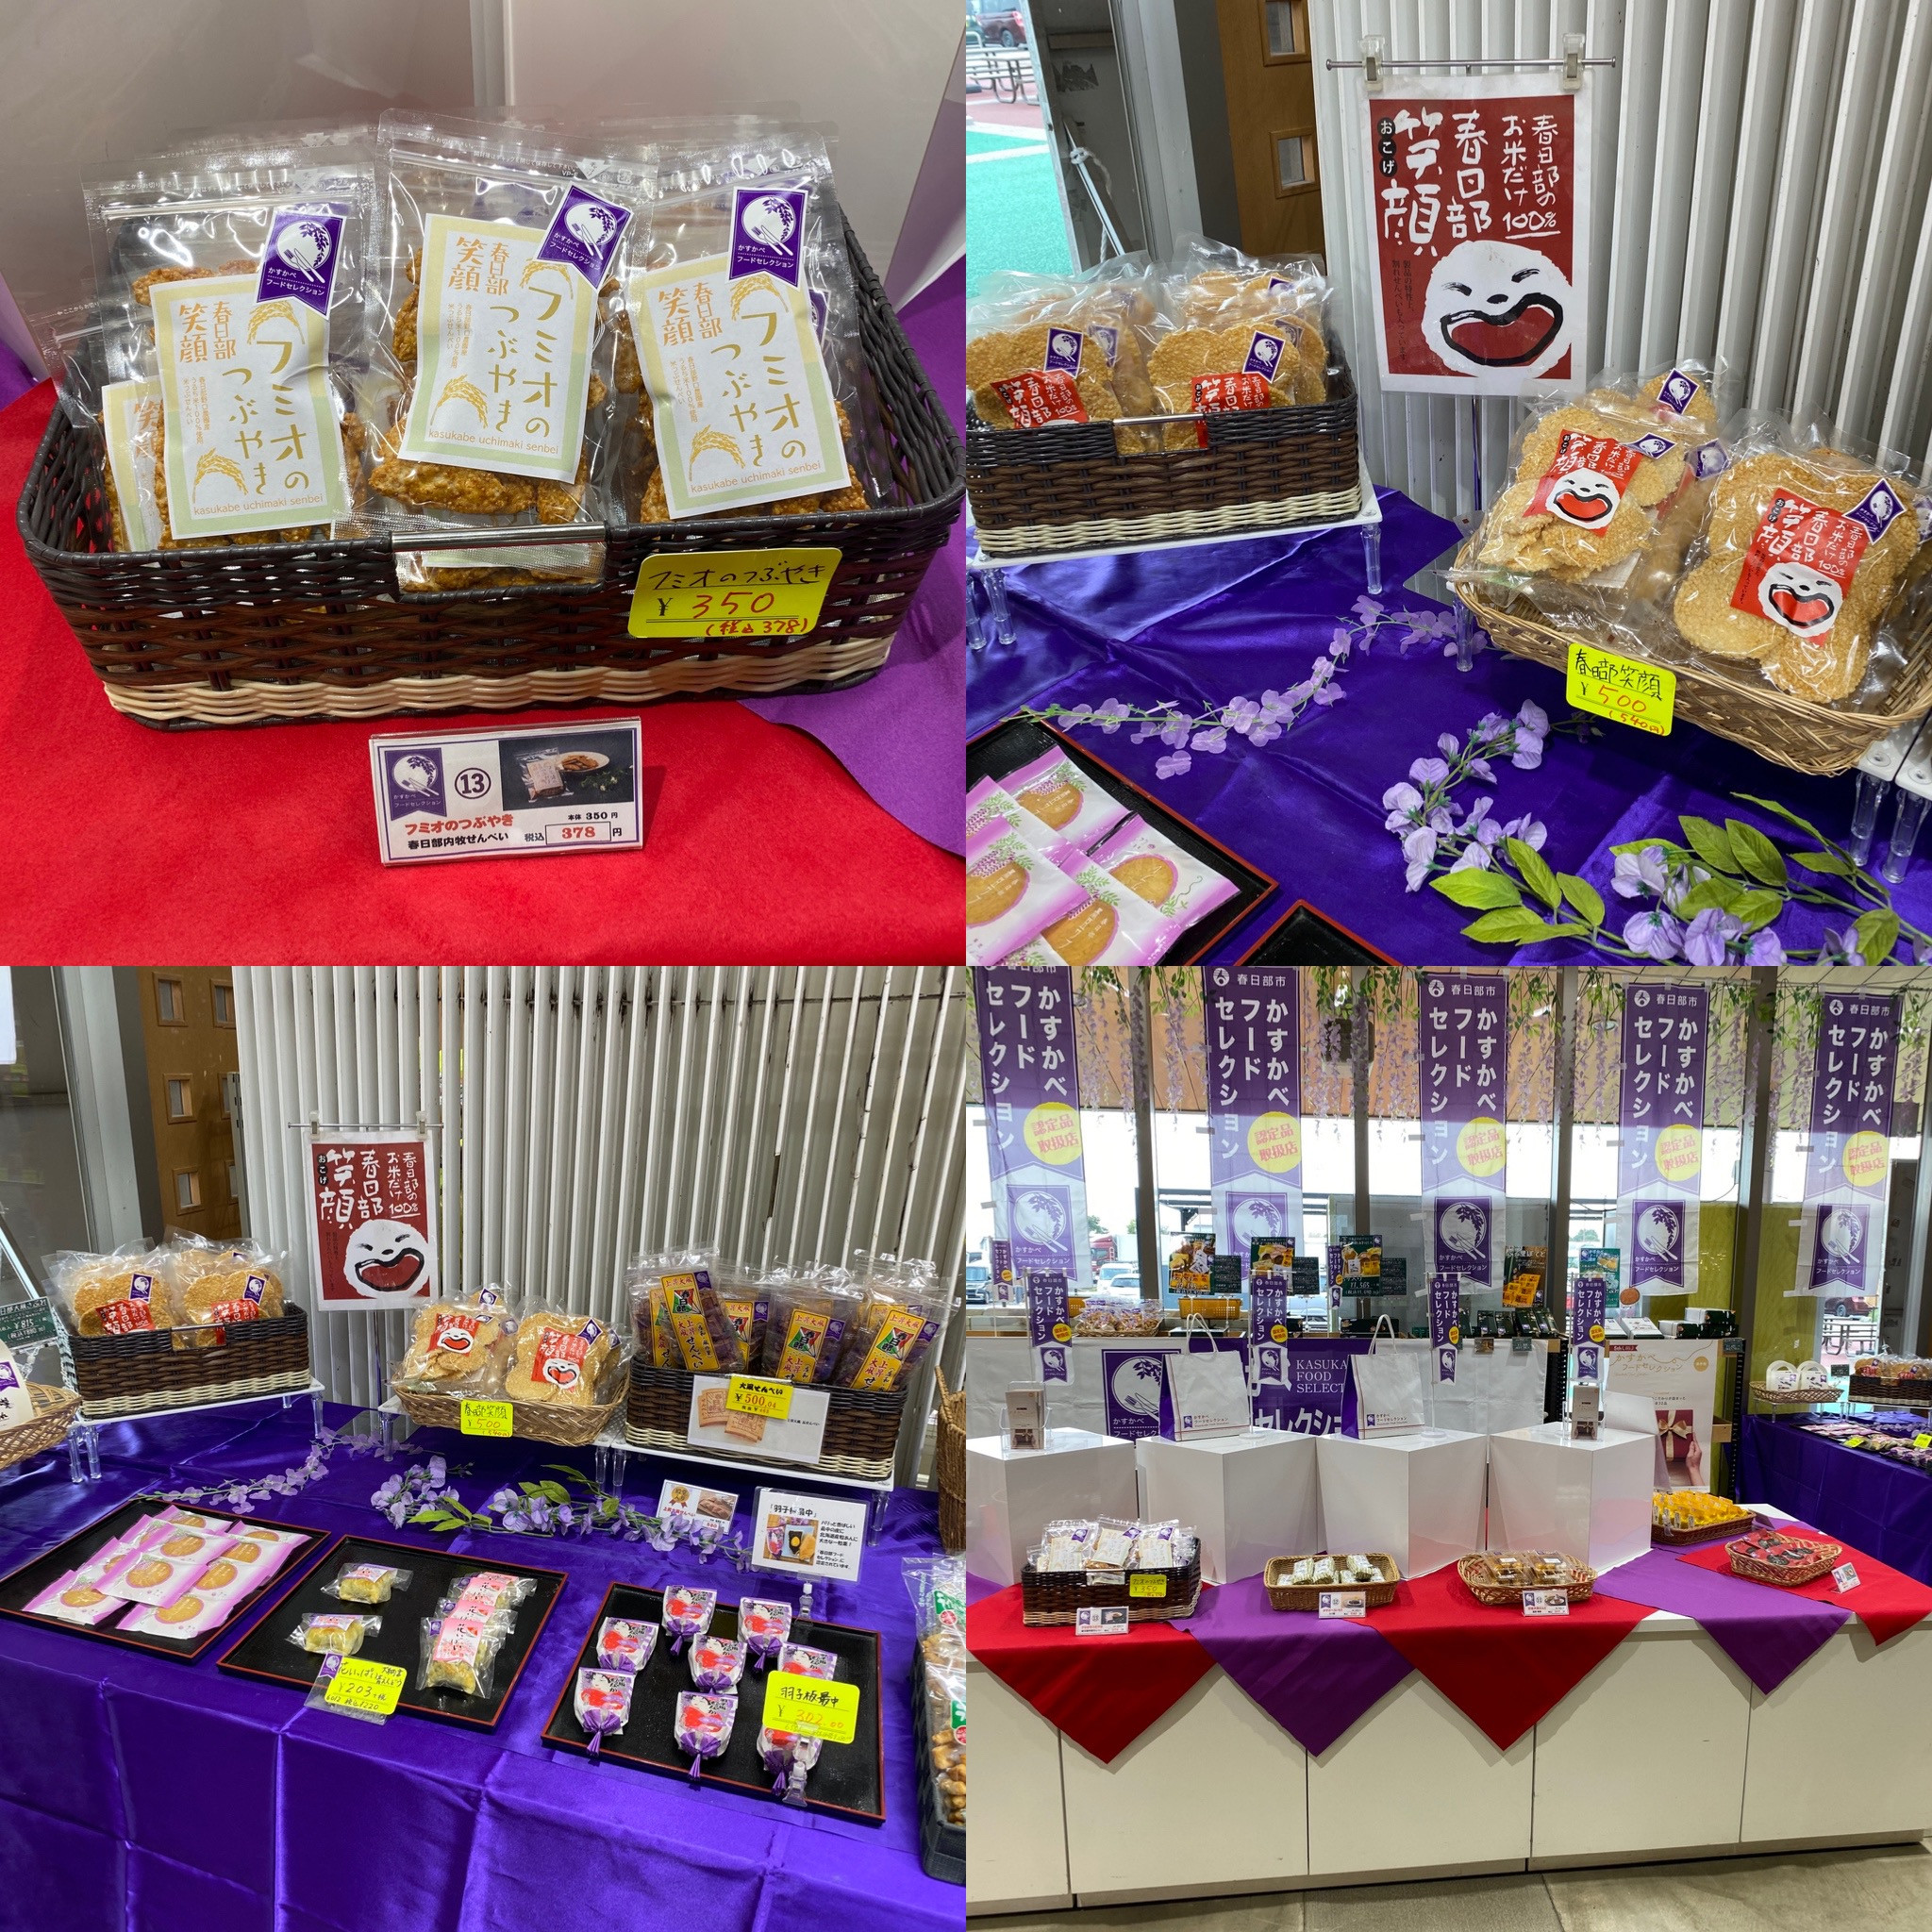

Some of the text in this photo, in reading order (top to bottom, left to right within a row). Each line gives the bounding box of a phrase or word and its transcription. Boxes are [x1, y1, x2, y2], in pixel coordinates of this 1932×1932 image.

[1380, 121, 1395, 175] おこげ
[1501, 114, 1529, 207] お米だけ
[1531, 114, 1560, 208] 春日部の
[1381, 107, 1445, 258] 笑顔
[1446, 109, 1493, 239] 春日部
[1502, 210, 1557, 232] 100%
[448, 236, 488, 293] 笑顔
[485, 242, 510, 297] 春日部
[549, 241, 602, 271] フードセレクション
[737, 256, 794, 269] フードセレクション
[266, 278, 325, 296] フードセレクション
[212, 301, 236, 360] 春日部
[658, 287, 695, 347] 笑顔
[693, 282, 724, 340] 春日部
[178, 303, 209, 364] 笑顔
[488, 305, 520, 433] つぶやき
[523, 286, 561, 439] フミオの
[710, 342, 764, 467] つぶやき
[741, 312, 808, 460] フミオの
[1024, 377, 1052, 424] 春日部
[222, 368, 268, 495] つぶやき
[256, 340, 310, 491] フミオの
[428, 428, 559, 455] kasukabe uchimaki senbei
[691, 460, 823, 494] kasukabe uchimaki senbei
[193, 492, 324, 517] kasukabe uchimaki senbei
[1767, 499, 1785, 524] おこげ
[1756, 499, 1811, 561] 笑顔
[1790, 510, 1829, 563] 春日部
[1824, 519, 1849, 560] お米だけ
[1839, 525, 1863, 567] 春日部の
[649, 560, 826, 590] フミオのつぶやき
[405, 814, 514, 836] フミオのつぶやき
[525, 825, 623, 842] 税込 378 円
[586, 812, 608, 821] 350
[408, 833, 509, 850] 春日部内牧せんべい
[1237, 974, 1287, 987] 春日部市
[1451, 984, 1496, 996] 春日部市
[1656, 993, 1698, 1007] 春日部市
[1010, 984, 1035, 1069] フード
[1849, 1004, 1890, 1017] 春日部市
[1039, 986, 1068, 1096] かすかべ
[1241, 999, 1261, 1081] フード
[1266, 999, 1290, 1107] かすかべ
[1454, 1008, 1473, 1088] フード
[1476, 1008, 1498, 1111] かすかべ
[1657, 1017, 1674, 1094] フード
[986, 981, 1014, 1150] セレクション
[1215, 996, 1240, 1159] セレクション
[1429, 1007, 1449, 1165] セレクション
[1674, 1017, 1698, 1120] かすかべ
[1847, 1027, 1866, 1103] フード
[1862, 1027, 1888, 1125] かすかべ
[1631, 1016, 1653, 1169] セレクション
[1818, 1024, 1845, 1174] セレクション
[1031, 1114, 1074, 1136] 認定品
[1037, 1131, 1079, 1154] 取扱店
[1255, 1123, 1294, 1145] 認定品
[1463, 1128, 1500, 1150] 認定品
[1660, 1134, 1696, 1155] 認定品
[318, 1155, 327, 1185] おこげ
[1259, 1141, 1298, 1163] 取扱店
[1467, 1145, 1504, 1166] 取扱店
[1662, 1151, 1698, 1172] 取扱店
[1848, 1141, 1883, 1161] 認定品
[1849, 1157, 1885, 1177] 取扱店
[319, 1147, 356, 1229] 笑顔
[358, 1149, 383, 1219] 春日部
[387, 1152, 404, 1200] お米だけ
[402, 1152, 419, 1202] 春日部の
[389, 1203, 418, 1214] 100%
[1015, 1257, 1071, 1265] フードセレクション
[1439, 1263, 1488, 1272] フードセレクション
[1635, 1265, 1679, 1274] フードセレクション
[1816, 1267, 1861, 1275] フードセレクション
[1034, 1286, 1045, 1341] セレクション
[1045, 1287, 1054, 1316] フード
[1055, 1287, 1065, 1324] かすかべ
[1256, 1288, 1265, 1341] セレクション
[1274, 1290, 1283, 1325] かすかべ
[1435, 1291, 1444, 1342] セレクション
[1577, 1290, 1586, 1341] セレクション
[1593, 1290, 1603, 1325] かすかべ
[1296, 1359, 1348, 1370] KASUKA
[1296, 1371, 1331, 1381] FOOD
[740, 1382, 783, 1395] 大凧せんべい
[780, 1686, 840, 1707] 羽子板最中
